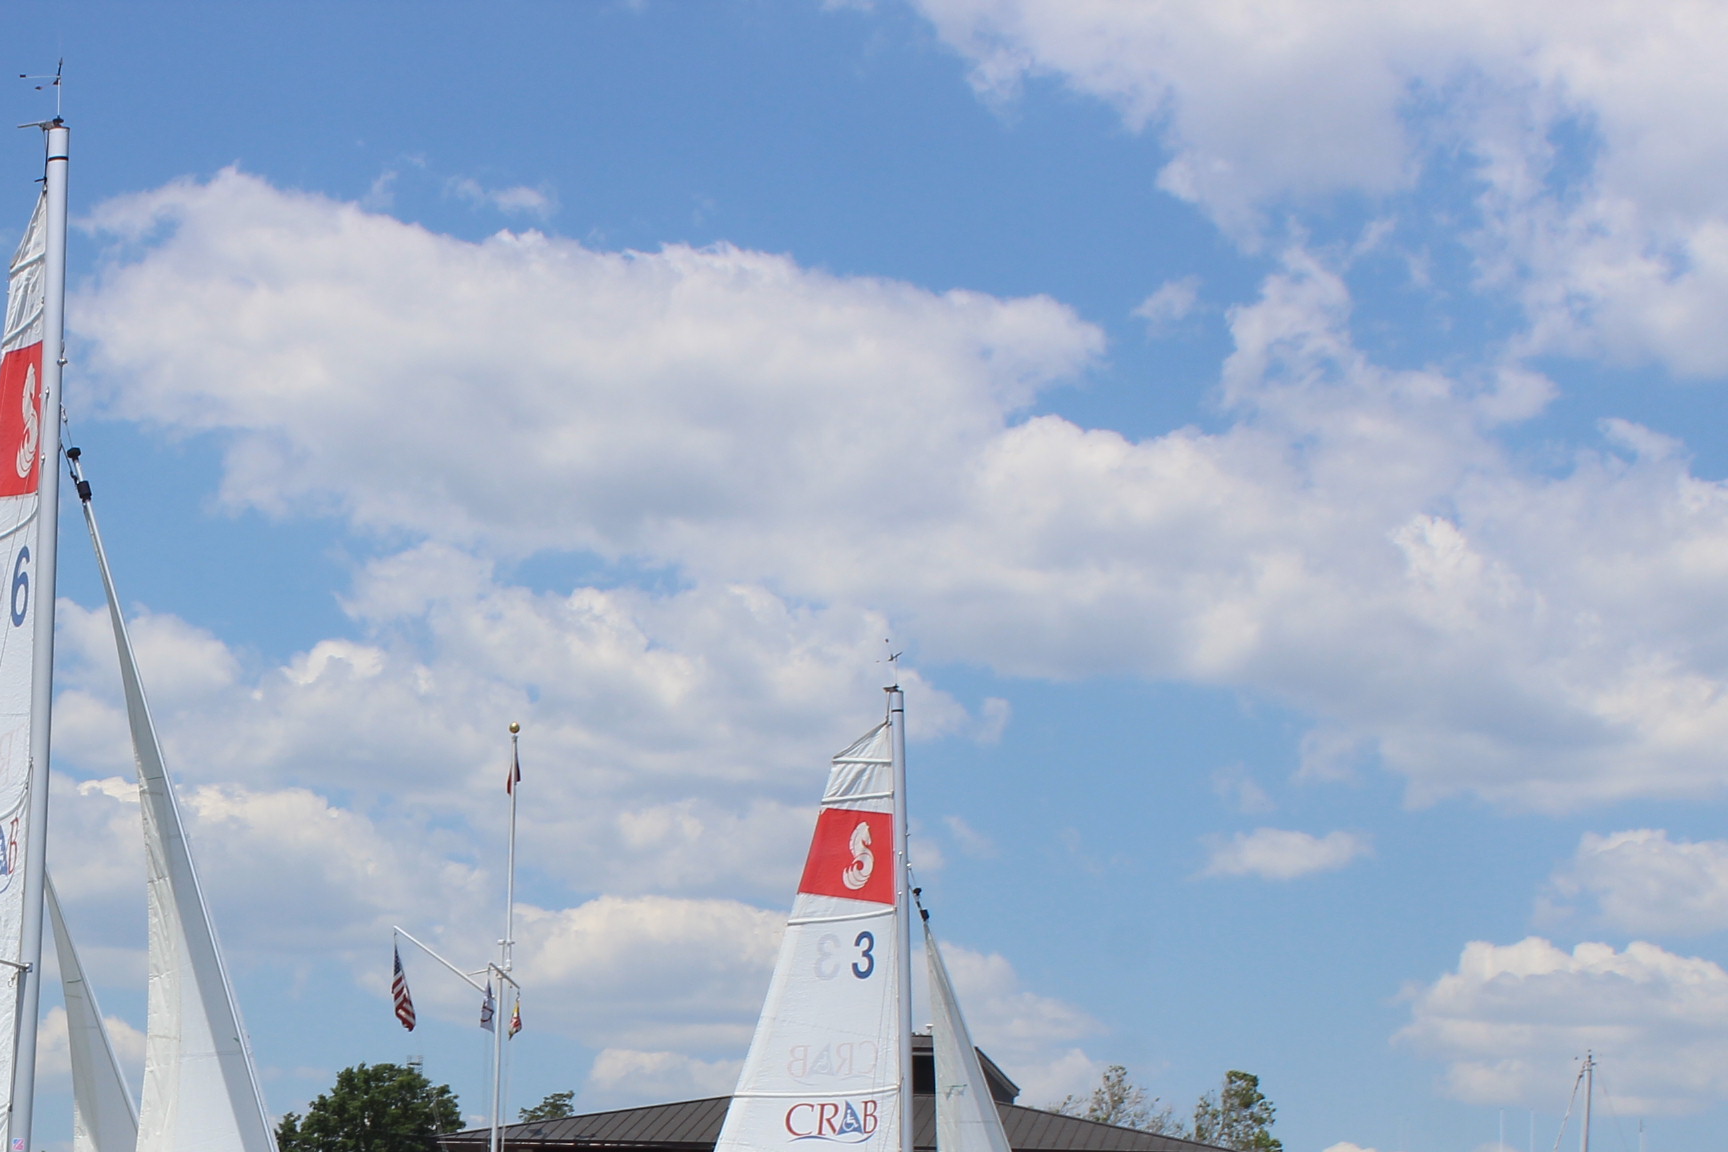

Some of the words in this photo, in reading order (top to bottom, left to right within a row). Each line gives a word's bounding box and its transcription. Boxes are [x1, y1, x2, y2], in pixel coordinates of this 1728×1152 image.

[11, 545, 30, 627] 6
[852, 931, 874, 979] 3
[785, 1100, 878, 1136] CRAB
